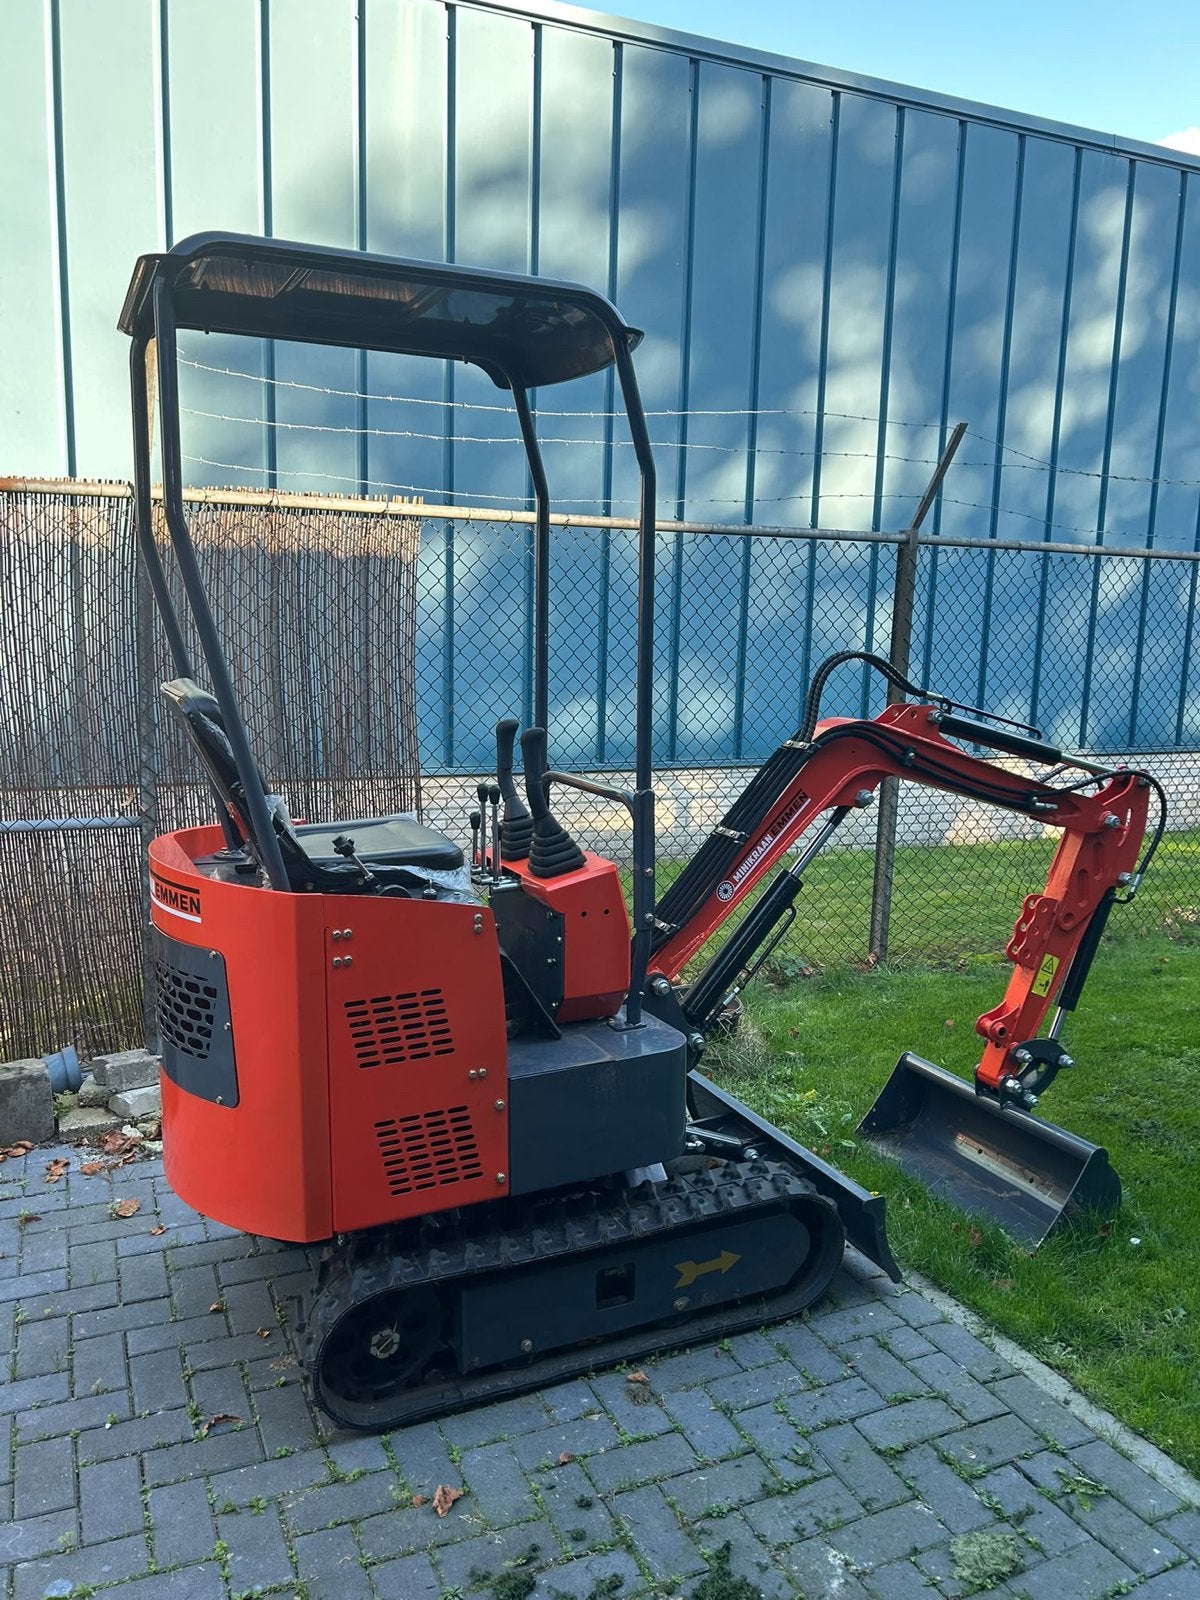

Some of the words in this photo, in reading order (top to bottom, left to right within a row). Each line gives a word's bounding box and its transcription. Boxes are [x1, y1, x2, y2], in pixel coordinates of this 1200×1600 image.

[732, 834, 774, 883] MINIKRAAN
[771, 791, 809, 837] EMMEN
[154, 882, 201, 914] EMMEN
